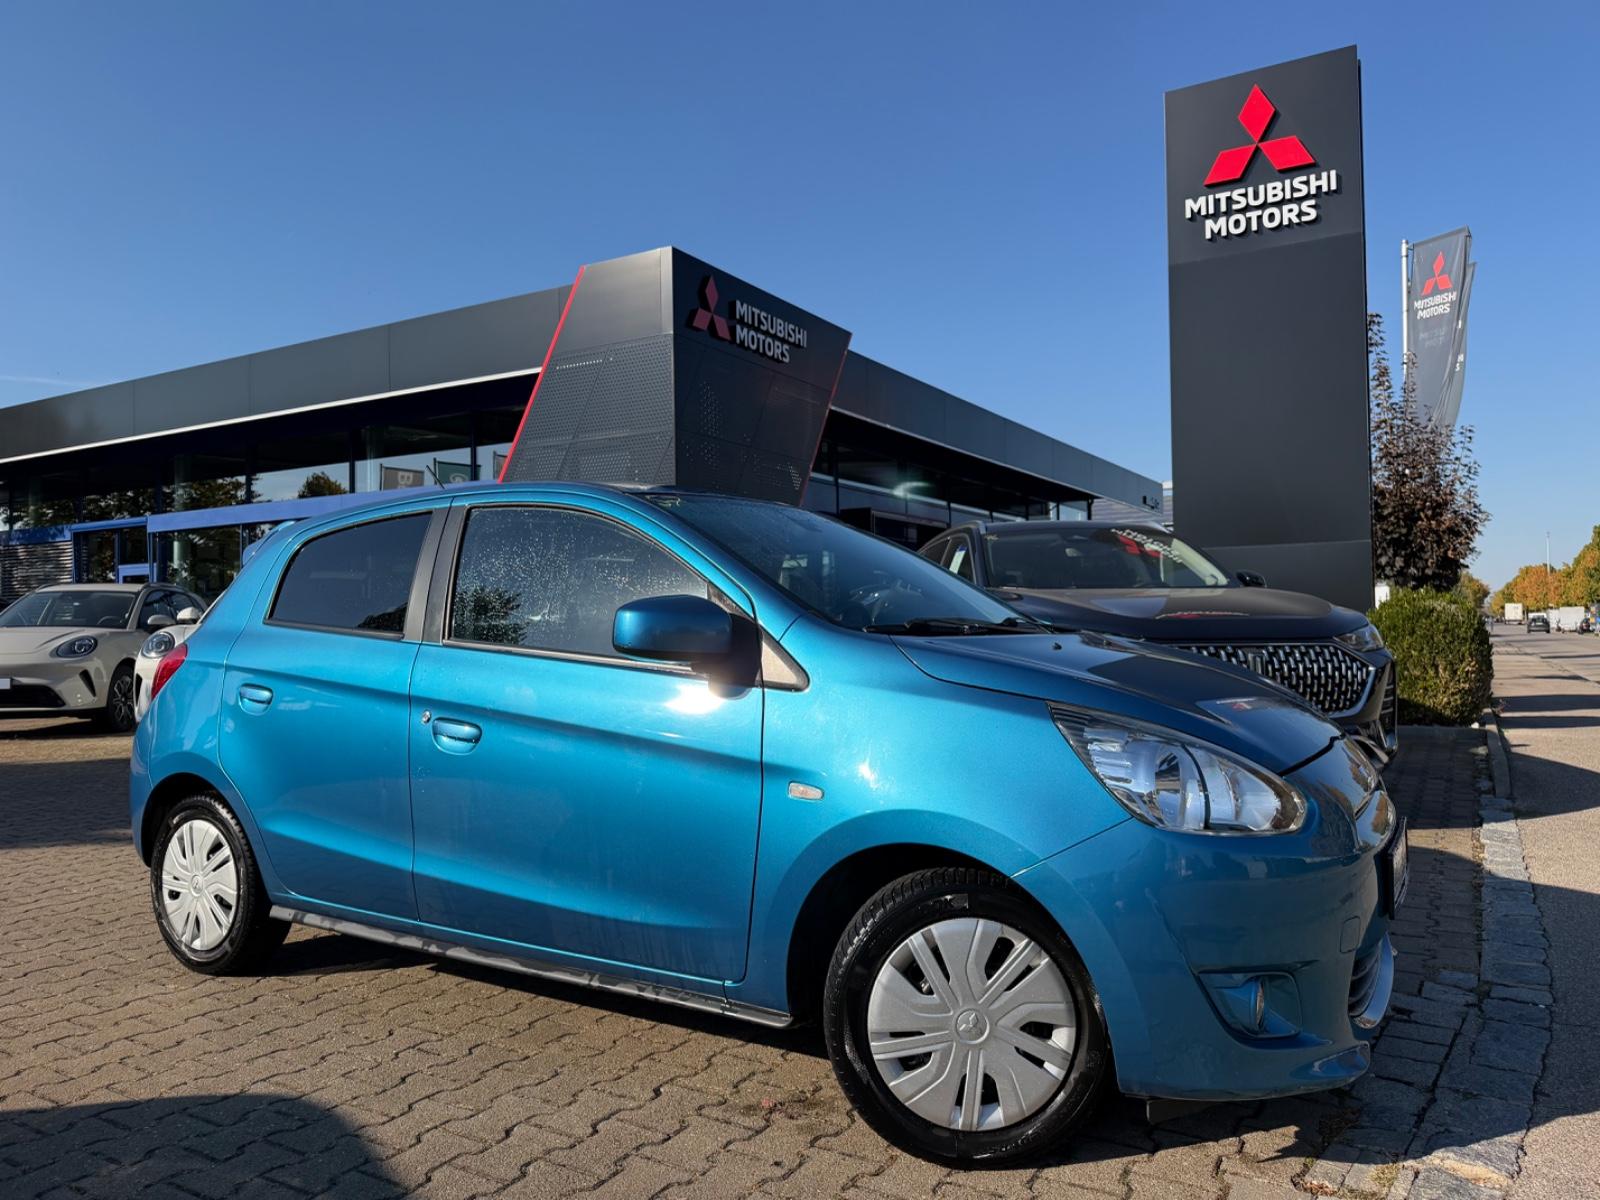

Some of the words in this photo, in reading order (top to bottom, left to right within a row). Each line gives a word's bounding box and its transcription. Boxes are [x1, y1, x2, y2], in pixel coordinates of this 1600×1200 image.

[1185, 169, 1337, 218] MITSUBISHI
[1205, 200, 1317, 239] MOTORS
[1414, 291, 1457, 310] MITSUBISHI
[1416, 304, 1451, 320] MOTORS
[736, 300, 807, 348] MITSUBISHI
[736, 325, 790, 363] MOTORS
